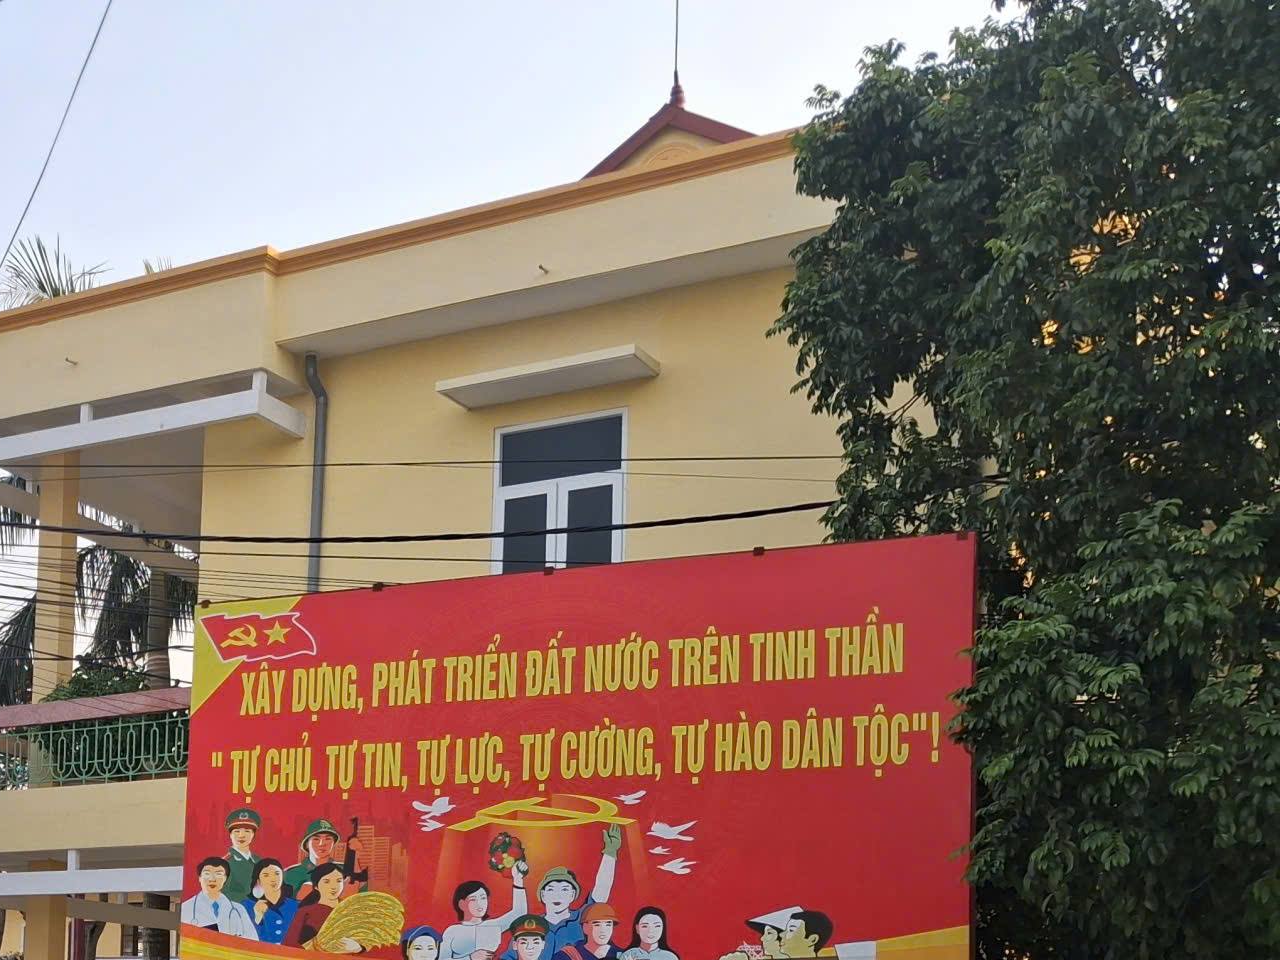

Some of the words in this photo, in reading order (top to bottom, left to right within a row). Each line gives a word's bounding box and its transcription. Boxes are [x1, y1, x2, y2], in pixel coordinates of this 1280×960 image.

[239, 661, 285, 715] XÂY
[292, 663, 363, 721] DỰNG,
[372, 650, 438, 706] PHÁT
[444, 634, 519, 702] TRIỂN
[525, 631, 577, 697] ĐẤT
[584, 631, 660, 692] NƯỚC
[668, 626, 741, 686] TRÊN
[750, 630, 816, 681] TINH
[825, 606, 904, 676] THẦN
[231, 745, 261, 803] TỰ
[265, 732, 317, 797] CHỦ,
[326, 740, 359, 800] TỰ
[363, 742, 408, 793] TIN,
[418, 734, 451, 795] TỰ
[455, 732, 511, 794] LỰC,
[520, 728, 556, 791] TỰ
[559, 717, 661, 781] CƯỜNG,
[671, 719, 709, 784] TỰ
[715, 711, 773, 771] HÀO
[782, 708, 843, 769] DÂN
